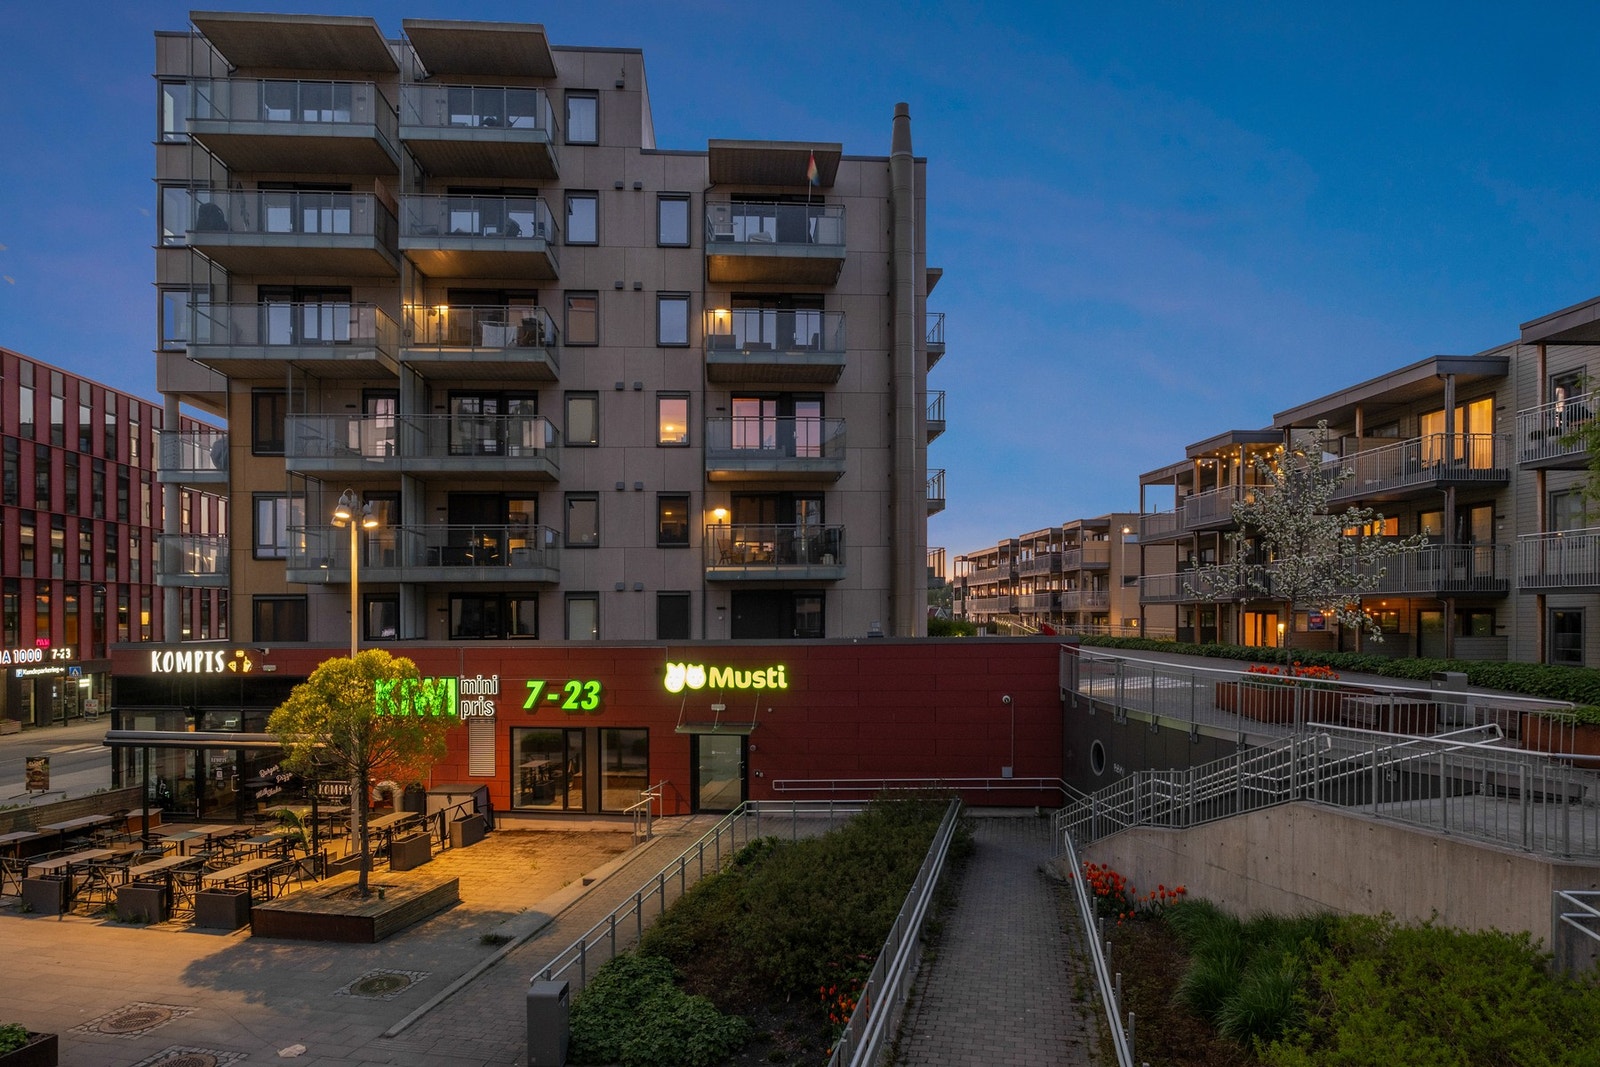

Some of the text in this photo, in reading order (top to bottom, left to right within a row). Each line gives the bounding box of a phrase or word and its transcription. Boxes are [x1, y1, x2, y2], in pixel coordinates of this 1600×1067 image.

[0, 648, 71, 664] A 1000 7-23
[151, 650, 225, 673] KOMPIS
[460, 674, 498, 695] mini
[708, 665, 788, 689] Musti
[522, 680, 602, 711] 7-23
[460, 696, 495, 720] pris
